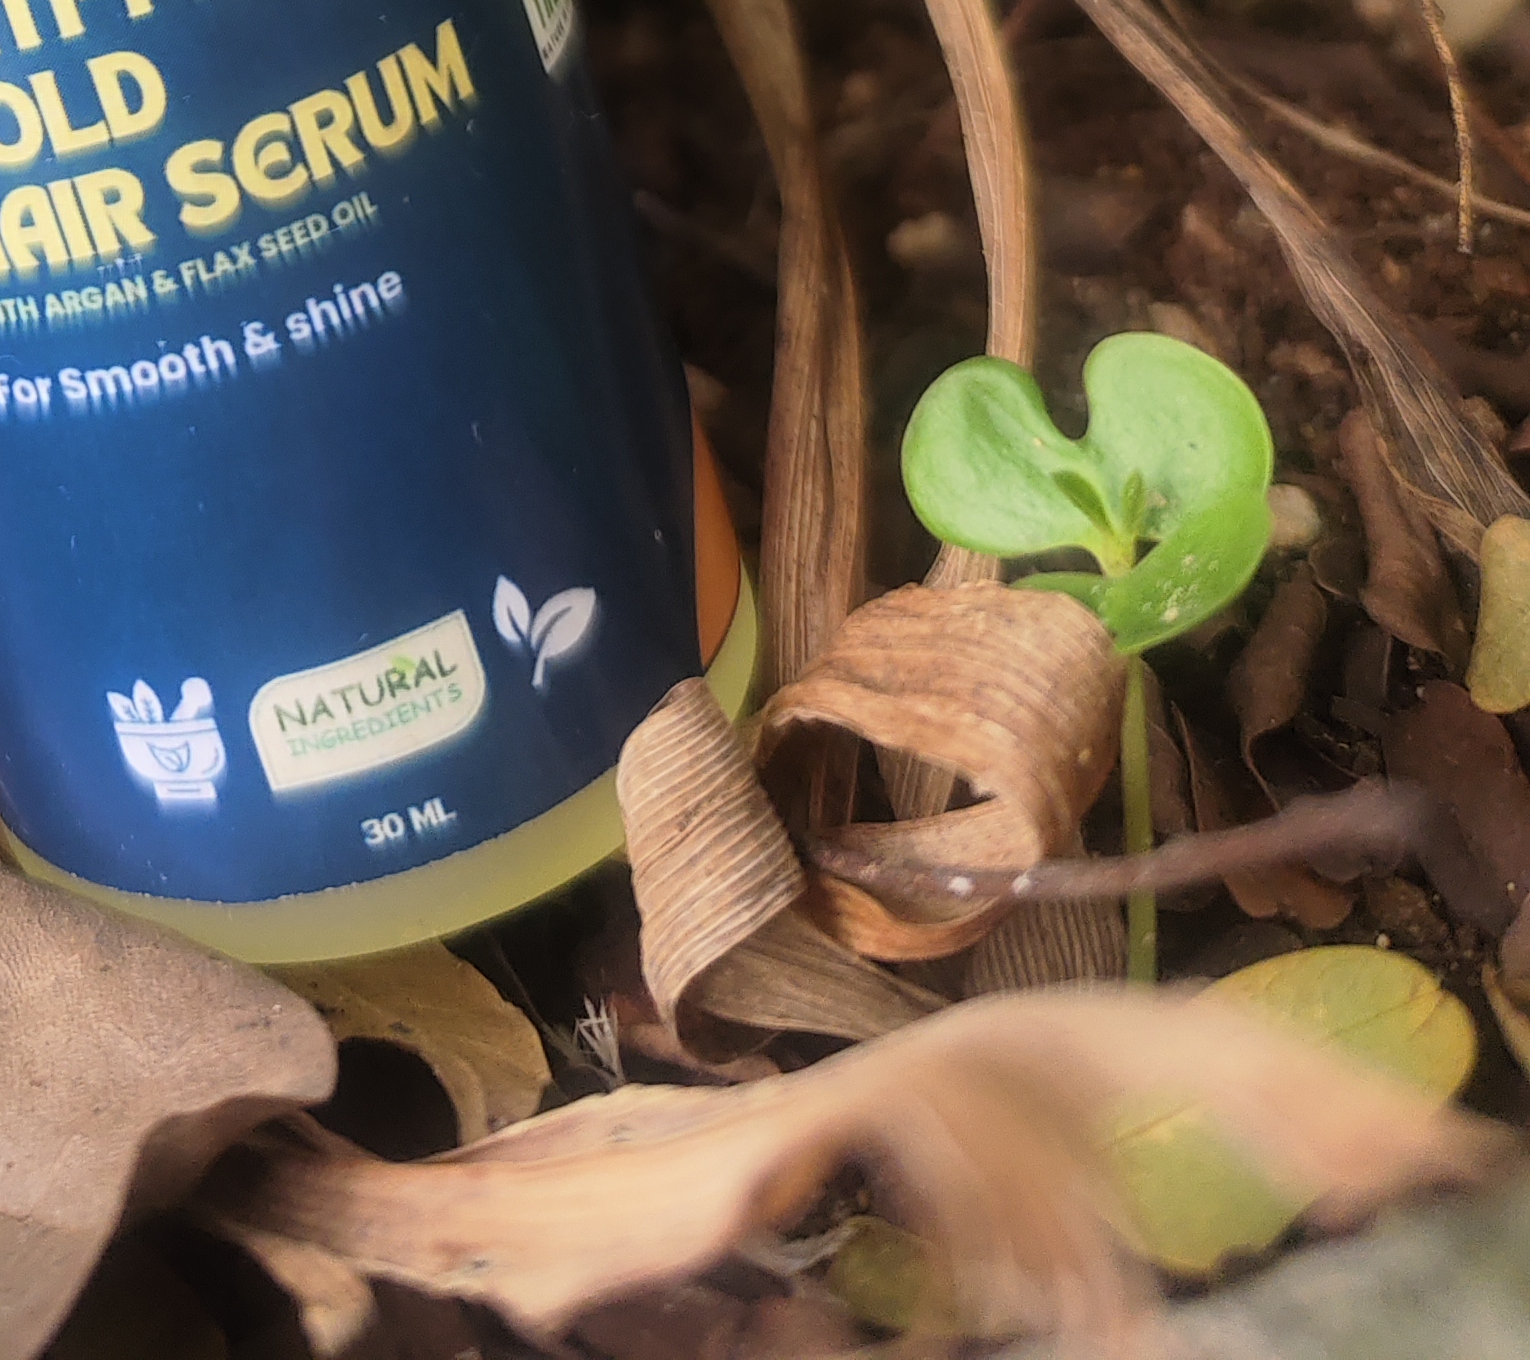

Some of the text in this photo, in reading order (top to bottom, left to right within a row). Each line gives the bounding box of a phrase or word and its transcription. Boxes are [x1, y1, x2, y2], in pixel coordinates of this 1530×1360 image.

[165, 18, 476, 228] SERUM
[45, 276, 148, 318] ARGAN
[151, 269, 178, 294] &
[179, 238, 257, 288] FLAX
[260, 213, 329, 258] SEED
[332, 191, 377, 226] OIL
[58, 335, 236, 400] Smooth
[244, 321, 281, 356] &
[285, 270, 404, 342] shine
[273, 650, 458, 732] NATURAL
[286, 682, 463, 757] INGREDIENTS
[361, 797, 458, 846] 30 ML
